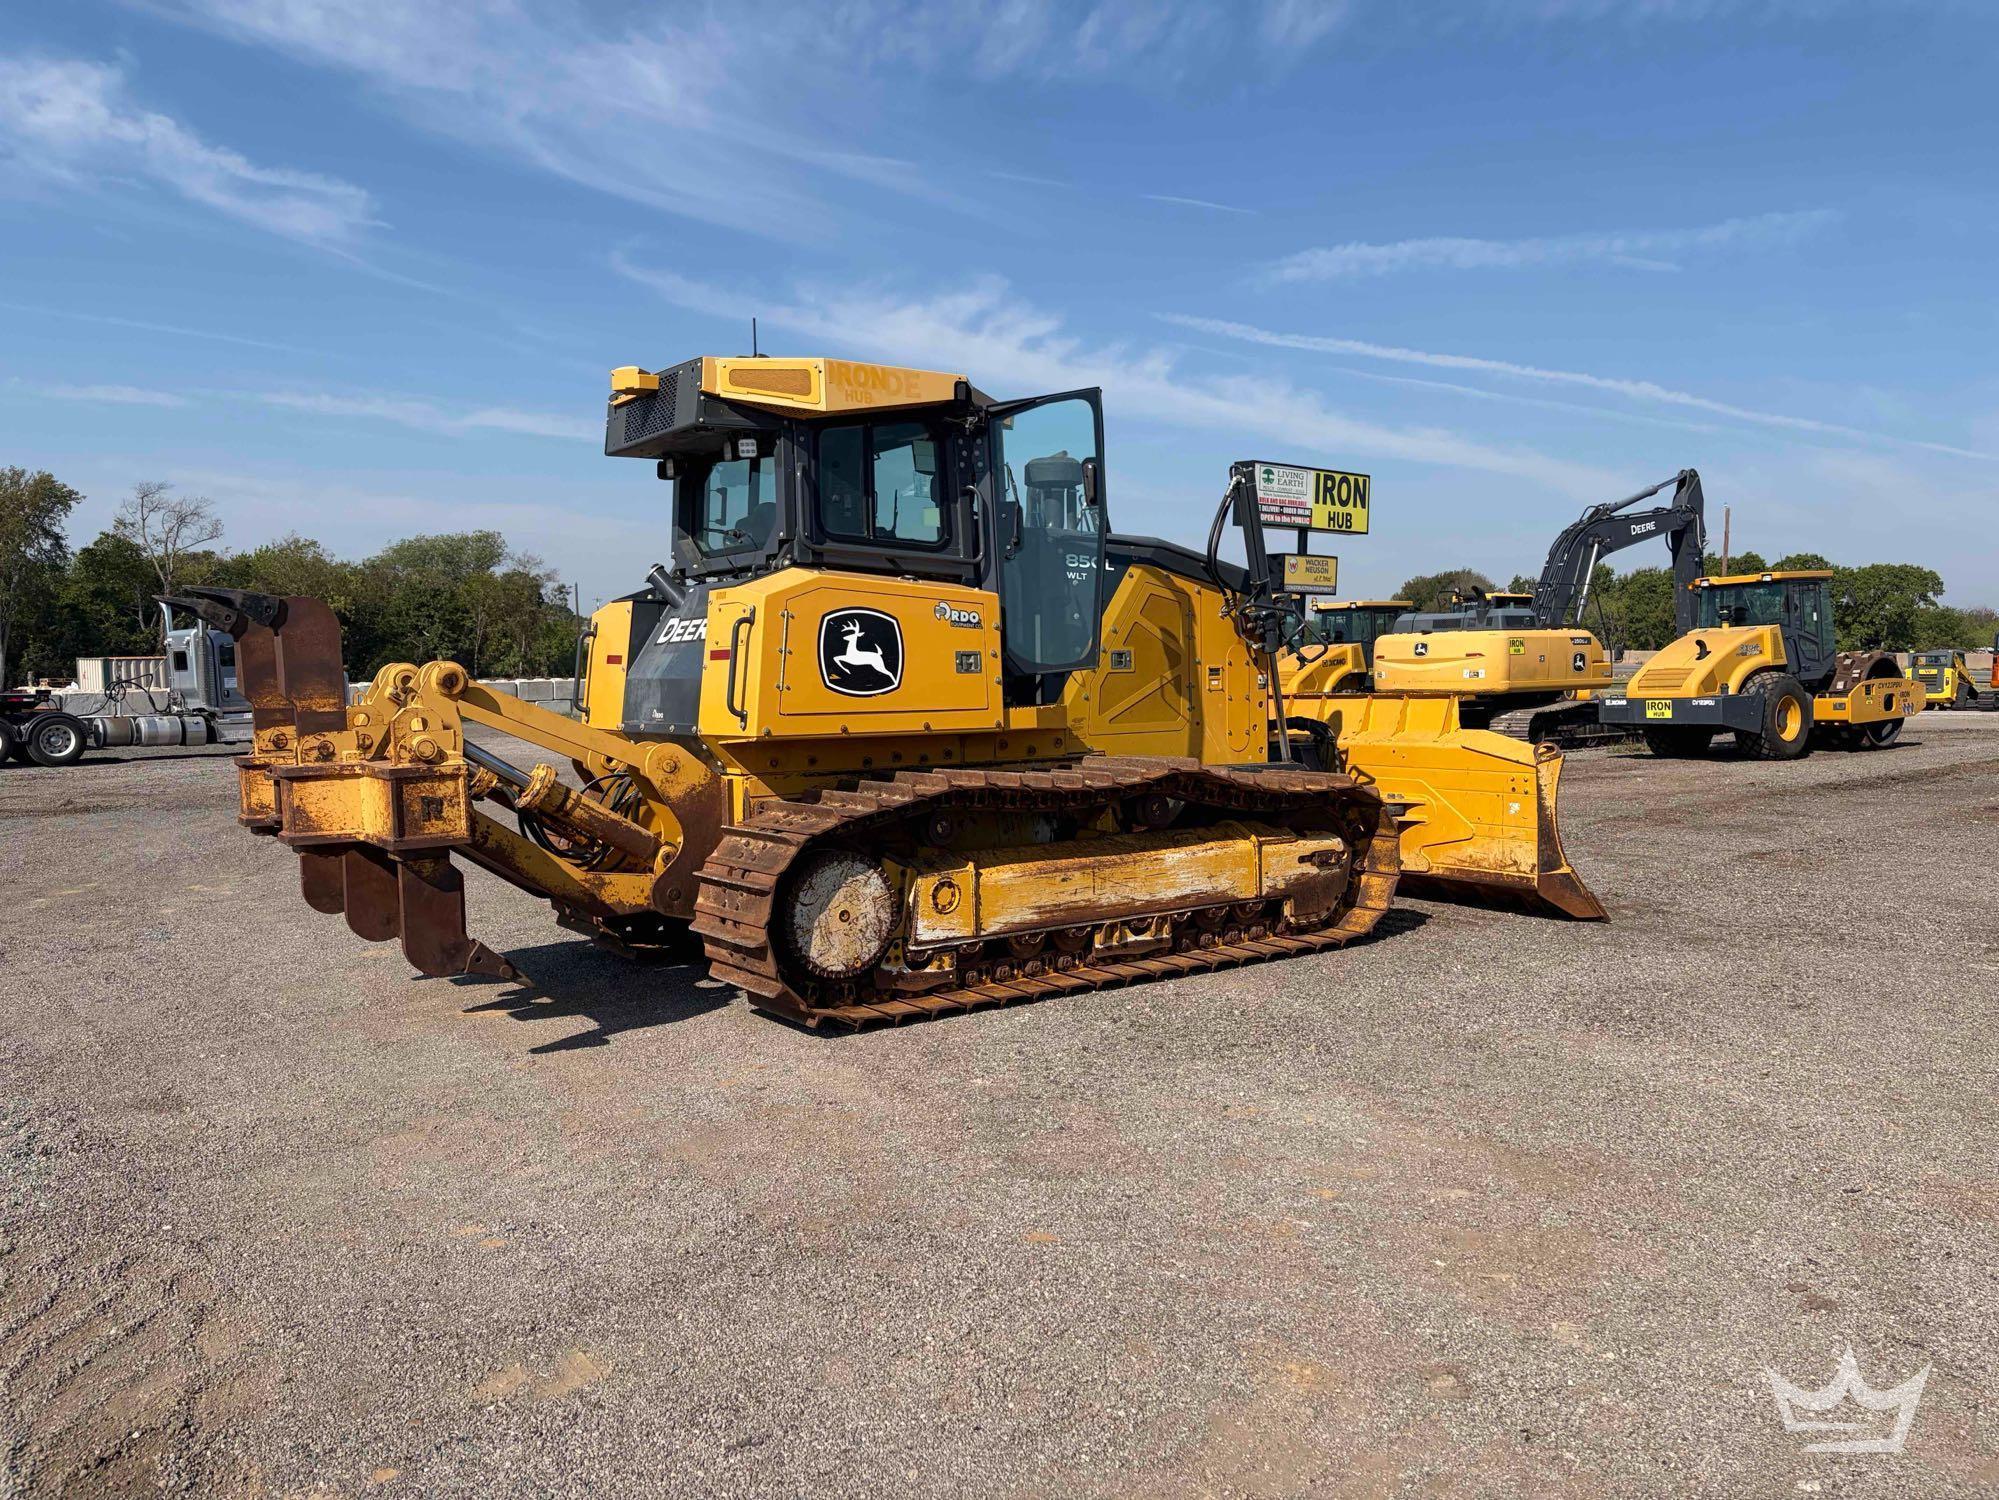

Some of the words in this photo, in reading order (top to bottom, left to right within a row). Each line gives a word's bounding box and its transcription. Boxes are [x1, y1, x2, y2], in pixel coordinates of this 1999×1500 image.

[845, 389, 872, 404] HUB
[1277, 470, 1304, 480] LIVING
[1277, 478, 1304, 488] EARTH
[1314, 472, 1367, 509] IRON
[1291, 516, 1311, 524] PUBLIC
[1327, 511, 1353, 529] HUB
[1630, 521, 1656, 535] DEERE
[1305, 559, 1329, 567] WACKER
[1305, 566, 1329, 574] NEUSON
[1066, 571, 1088, 580] WLT
[951, 609, 980, 623] RDO
[1509, 639, 1524, 647] IRON
[1647, 701, 1671, 711] IRON
